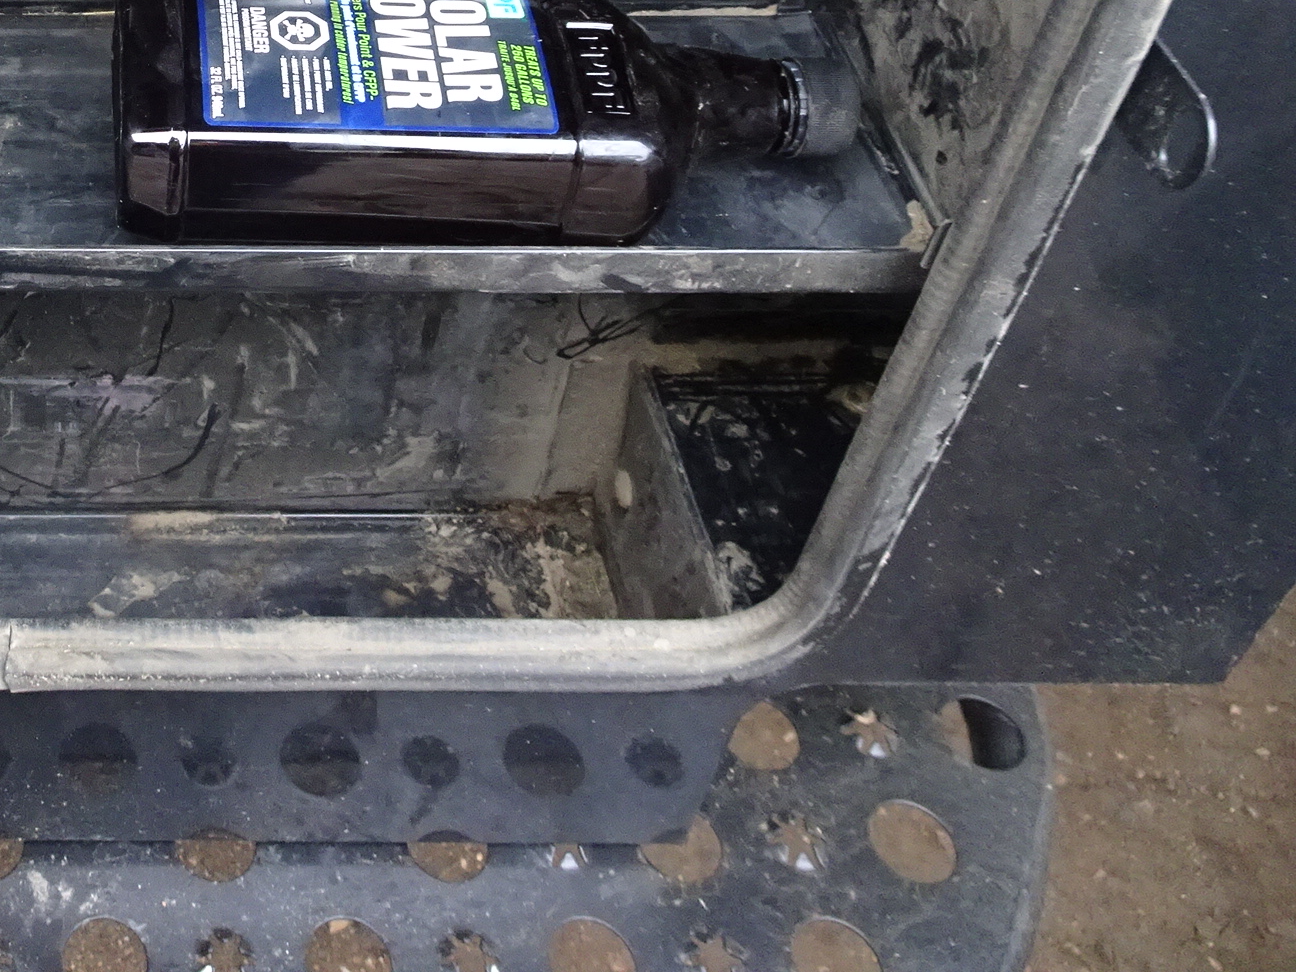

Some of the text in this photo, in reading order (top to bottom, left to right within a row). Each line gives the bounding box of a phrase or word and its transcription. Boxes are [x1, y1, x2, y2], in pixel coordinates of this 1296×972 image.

[250, 7, 270, 53] DANGER
[355, 12, 367, 32] Pour
[334, 30, 347, 51] colder
[358, 34, 372, 58] Point
[363, 60, 373, 68] &
[524, 46, 548, 106] TREATS UP TO
[515, 64, 534, 105] GALLONS
